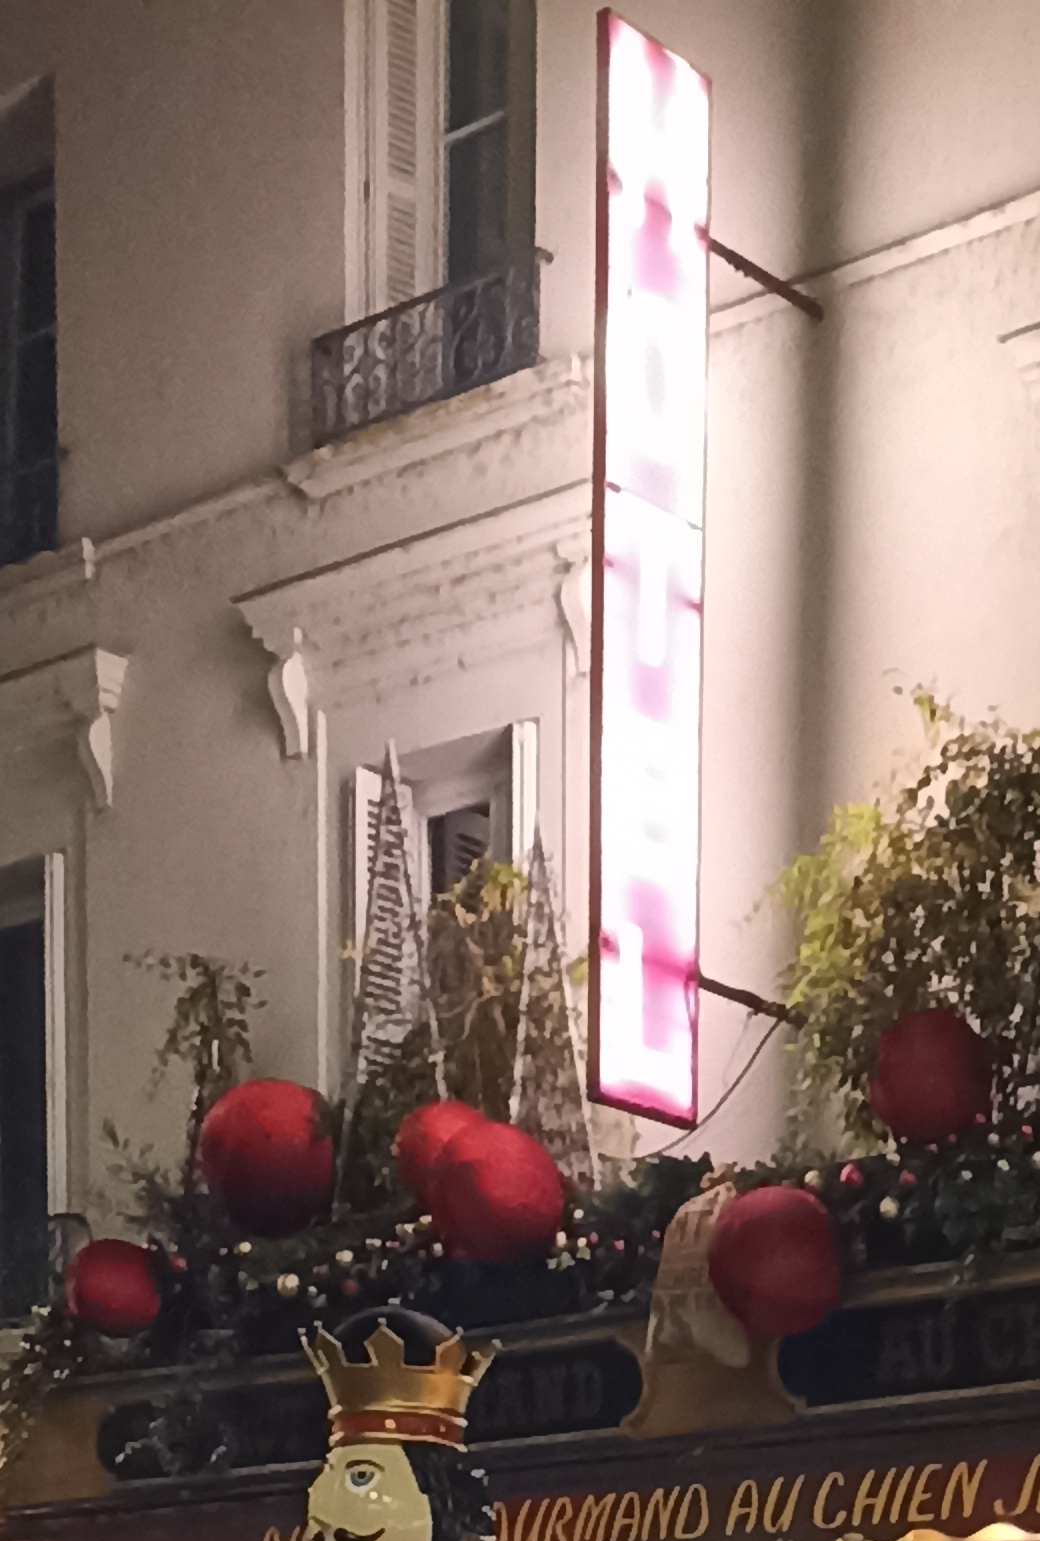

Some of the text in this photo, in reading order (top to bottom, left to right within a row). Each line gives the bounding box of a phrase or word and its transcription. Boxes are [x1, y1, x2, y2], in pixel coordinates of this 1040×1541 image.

[876, 1306, 960, 1384] AU
[725, 1473, 805, 1537] AU
[812, 1458, 989, 1530] CHIEN
